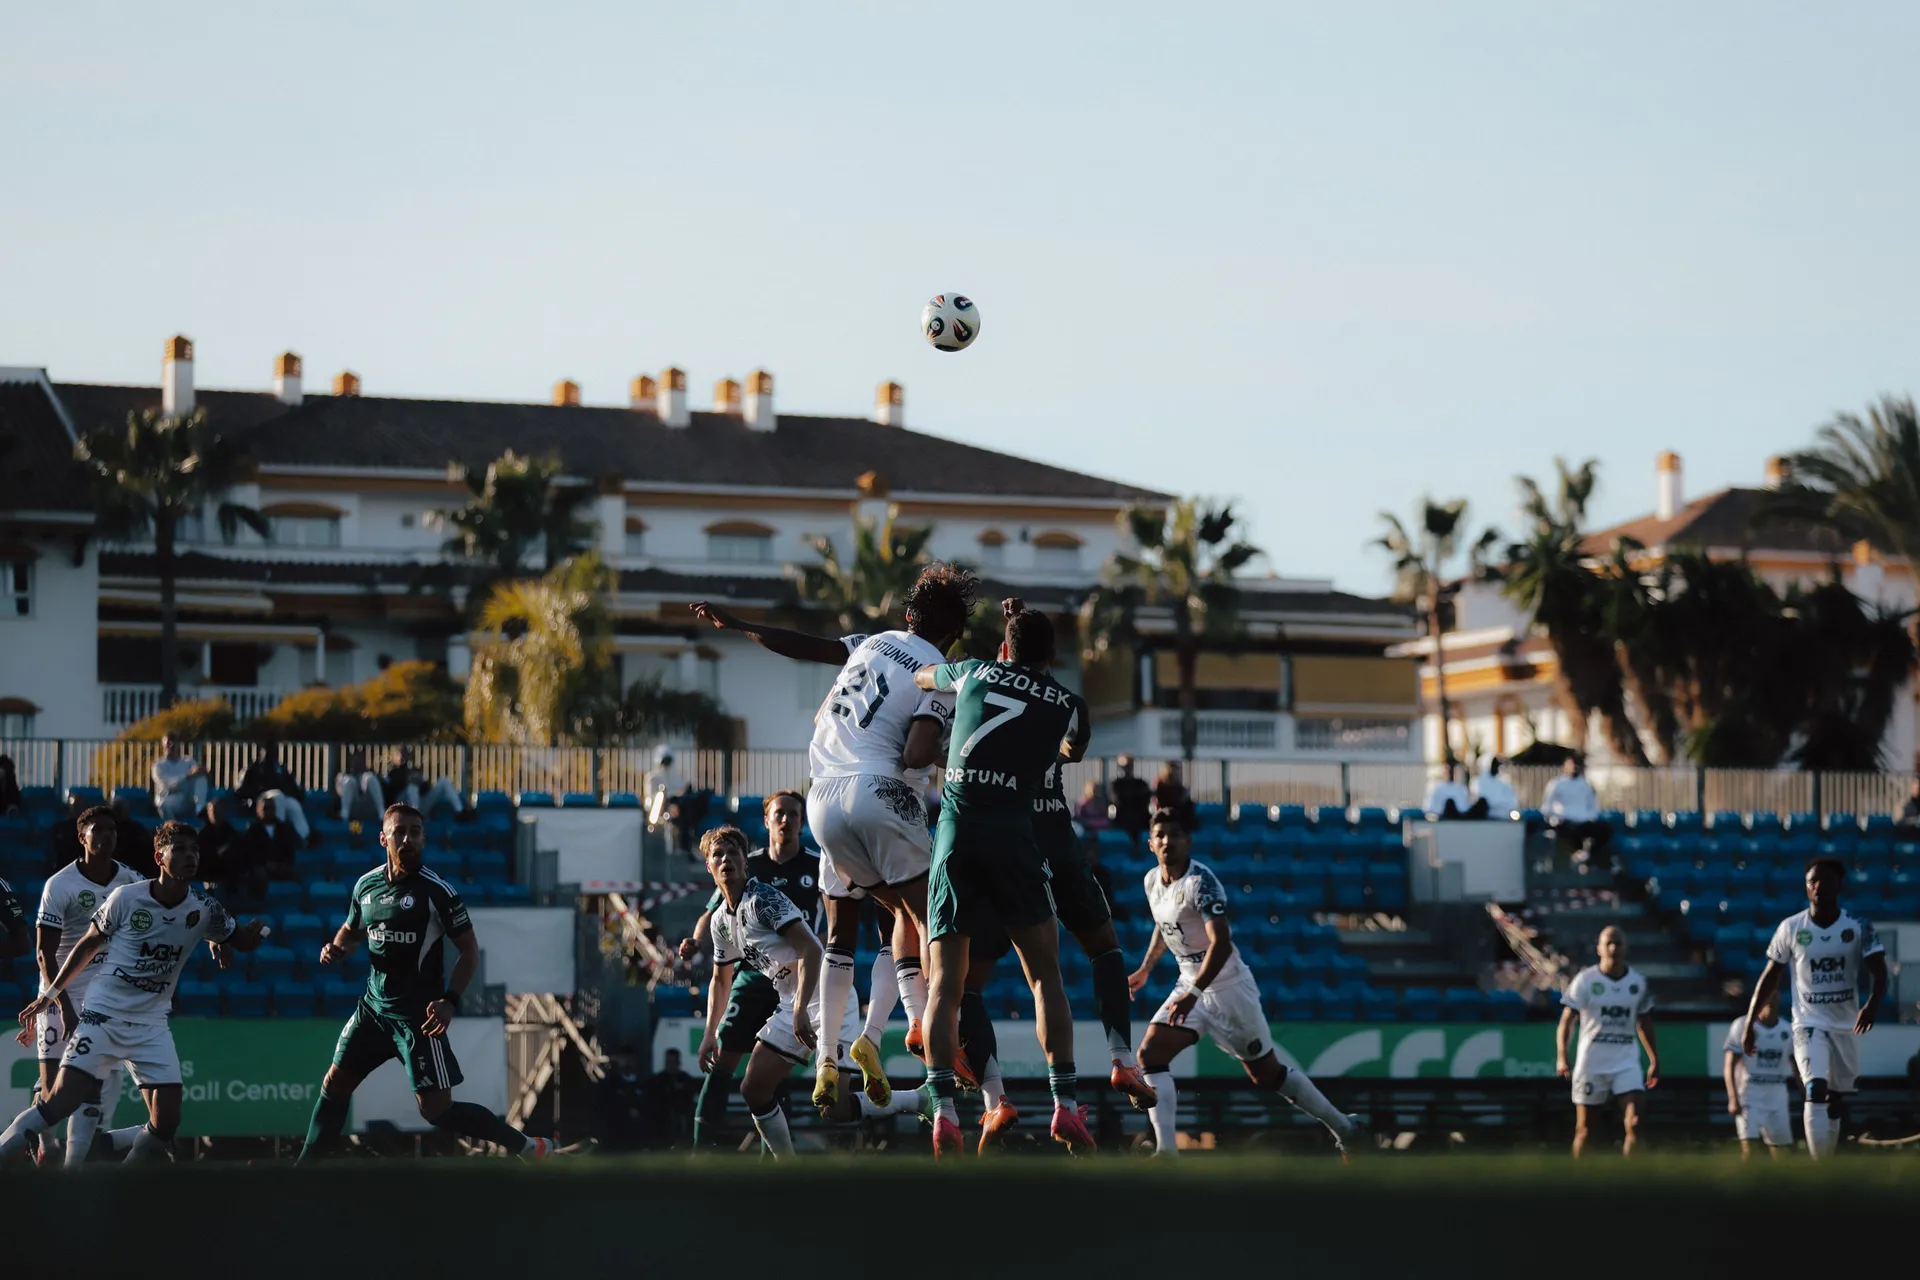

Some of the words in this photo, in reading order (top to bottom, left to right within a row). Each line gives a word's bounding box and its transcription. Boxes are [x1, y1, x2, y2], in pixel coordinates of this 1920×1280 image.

[864, 638, 923, 674] UTIUNIAN
[972, 662, 1072, 710] WSZOŁEK
[959, 691, 1029, 759] 7
[944, 767, 1018, 792] ORTUNA
[1211, 903, 1224, 915] C
[140, 942, 183, 962] MBH
[135, 959, 176, 976] BANK
[1810, 956, 1846, 973] MBH
[227, 1079, 316, 1102] Center
